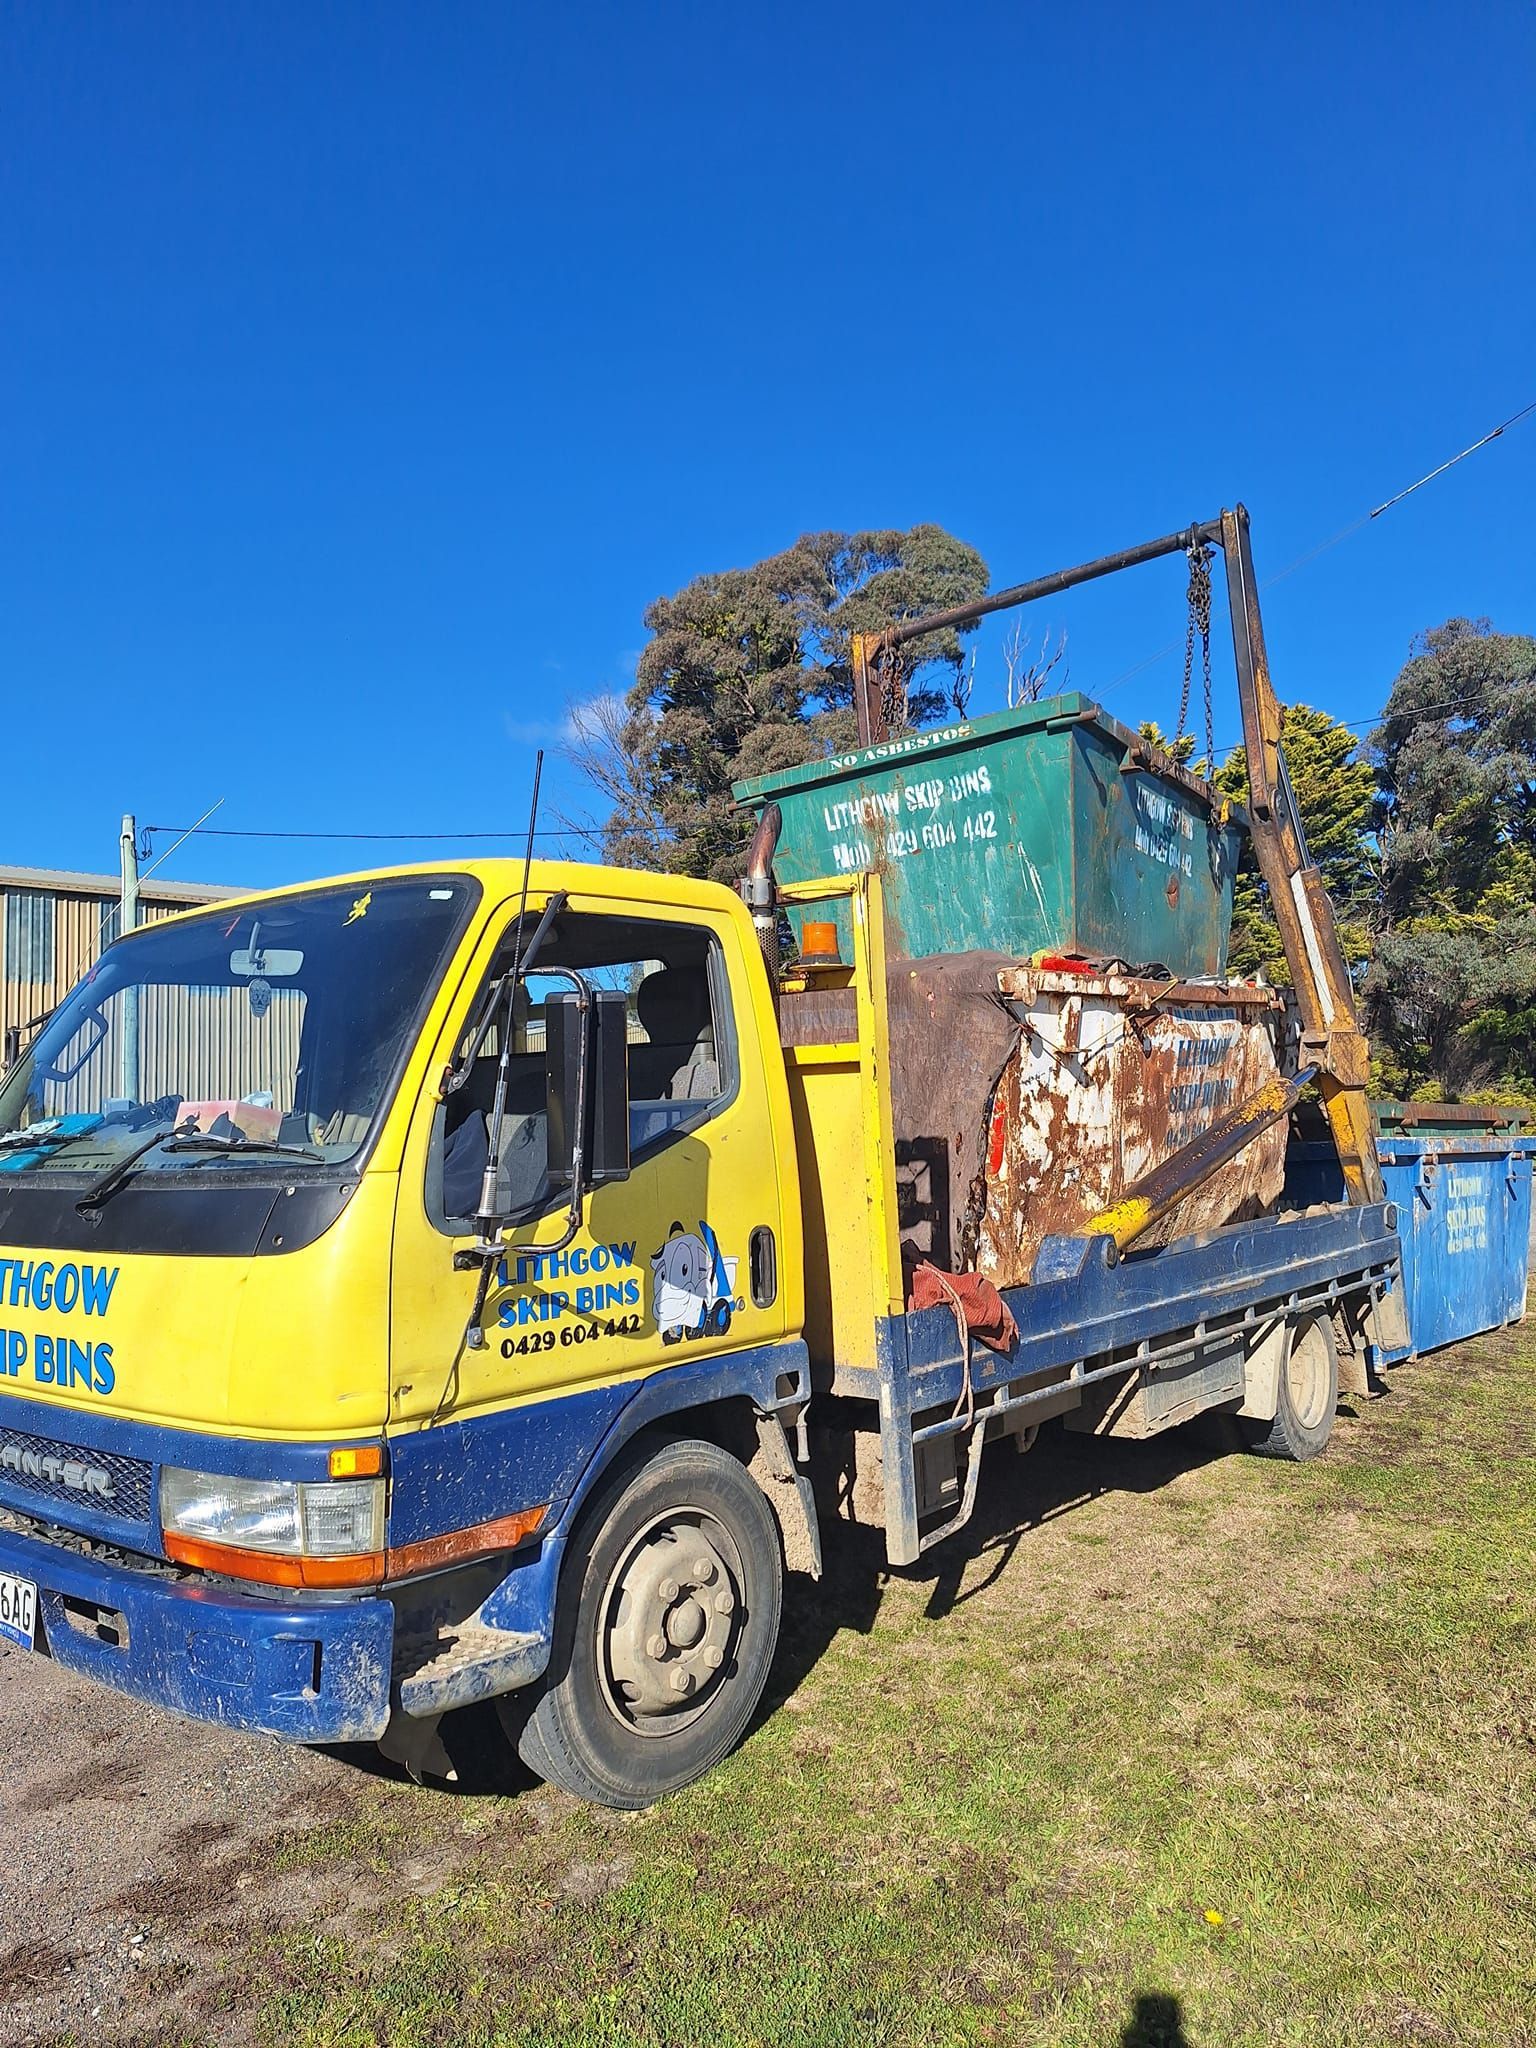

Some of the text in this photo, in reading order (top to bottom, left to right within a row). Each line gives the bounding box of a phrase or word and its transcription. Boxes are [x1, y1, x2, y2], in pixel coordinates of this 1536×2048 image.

[829, 724, 974, 771] NO ASBESTOS
[904, 778, 945, 813] SKIP
[950, 765, 992, 803] BINS
[877, 829, 919, 857] 429
[921, 821, 957, 849] 604
[963, 810, 998, 842] 442
[496, 1241, 637, 1288] LITHGOW
[498, 1278, 640, 1329] SKIP BINS
[500, 1313, 641, 1359] 0429 604 442
[35, 1334, 116, 1395] BINS
[1, 1581, 32, 1632] 6AG
